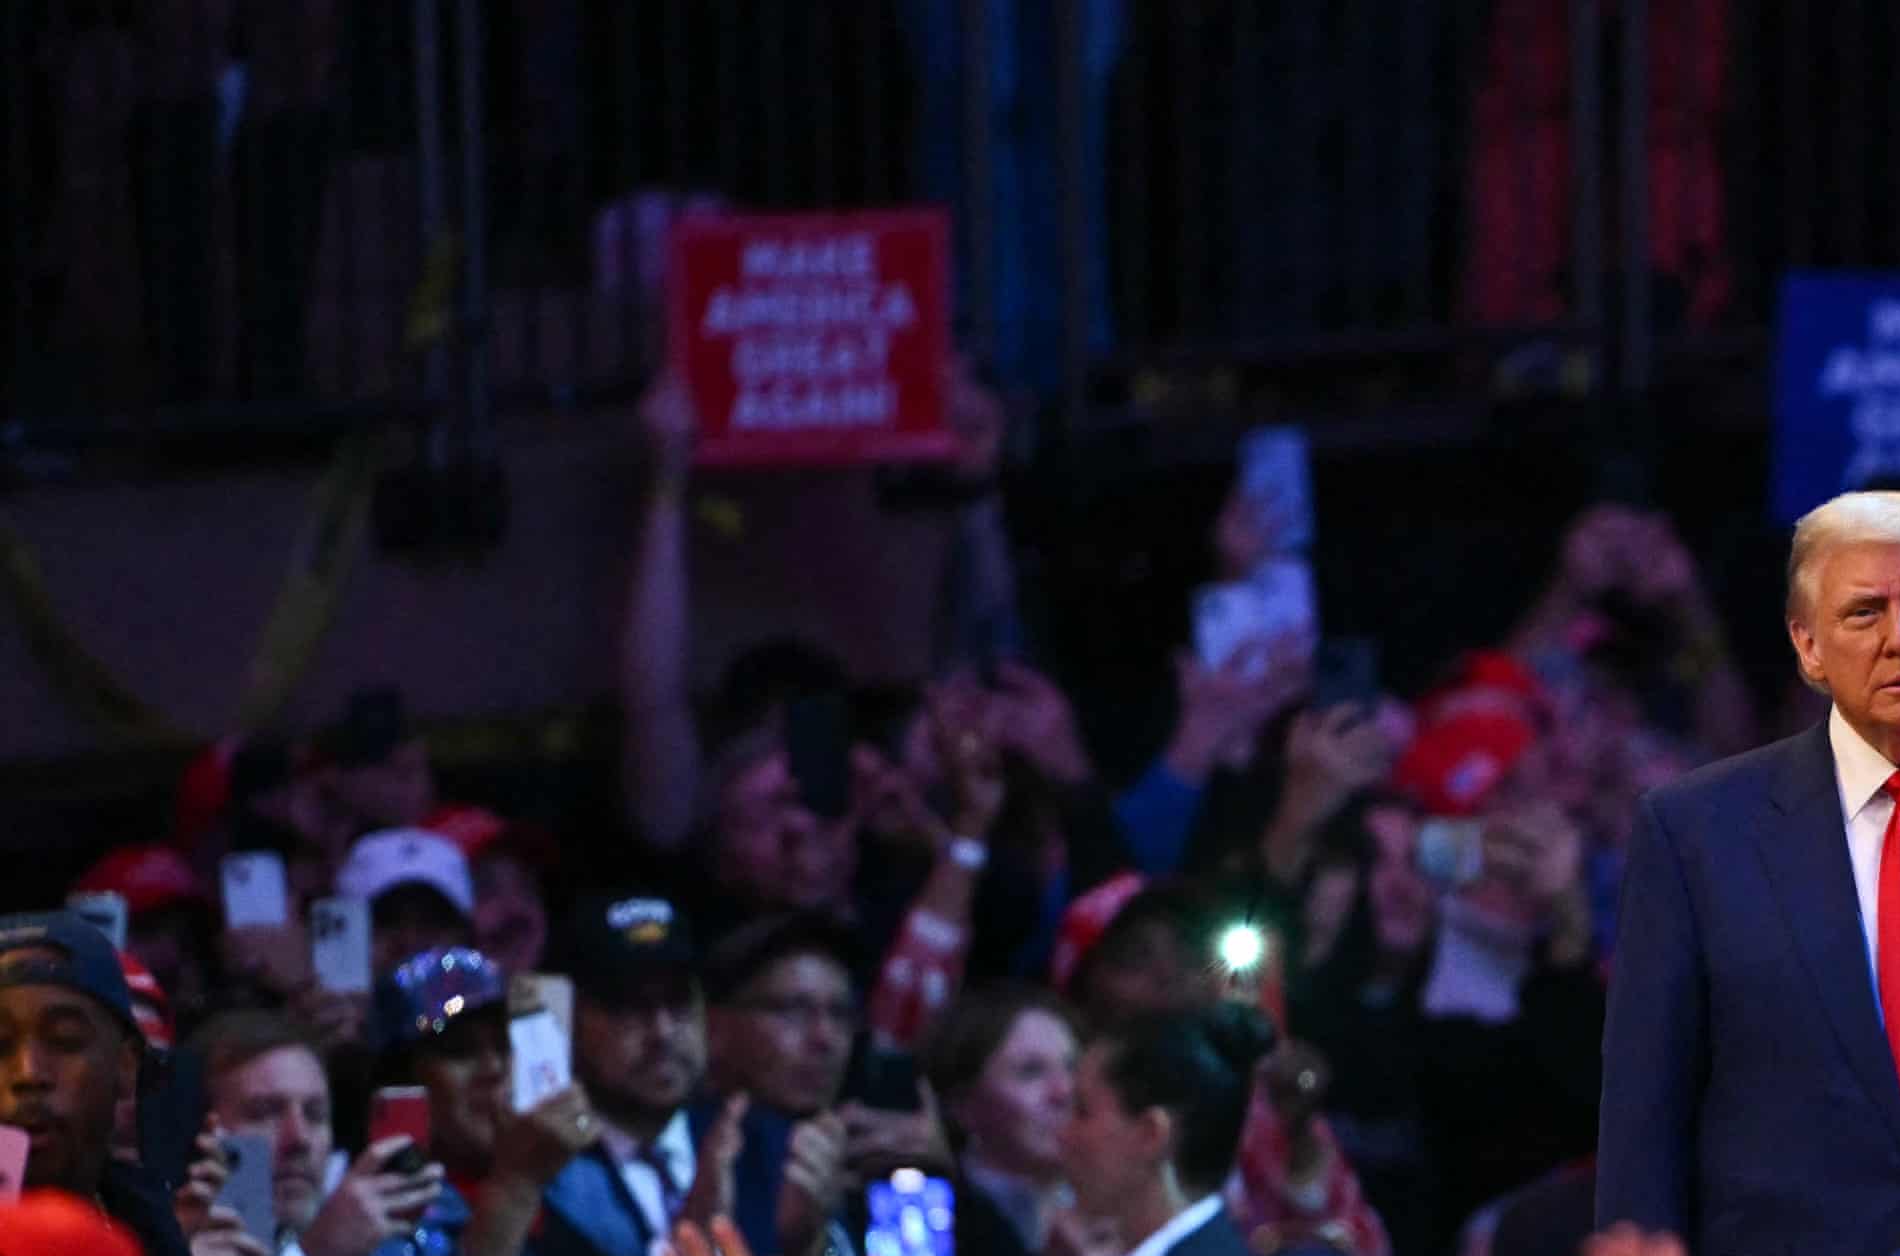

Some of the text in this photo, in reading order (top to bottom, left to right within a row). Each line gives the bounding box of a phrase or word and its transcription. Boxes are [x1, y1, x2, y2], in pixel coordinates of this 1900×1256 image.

[743, 235, 874, 276] MAKE
[704, 281, 914, 335] AMERICA
[732, 325, 888, 376] GREAT
